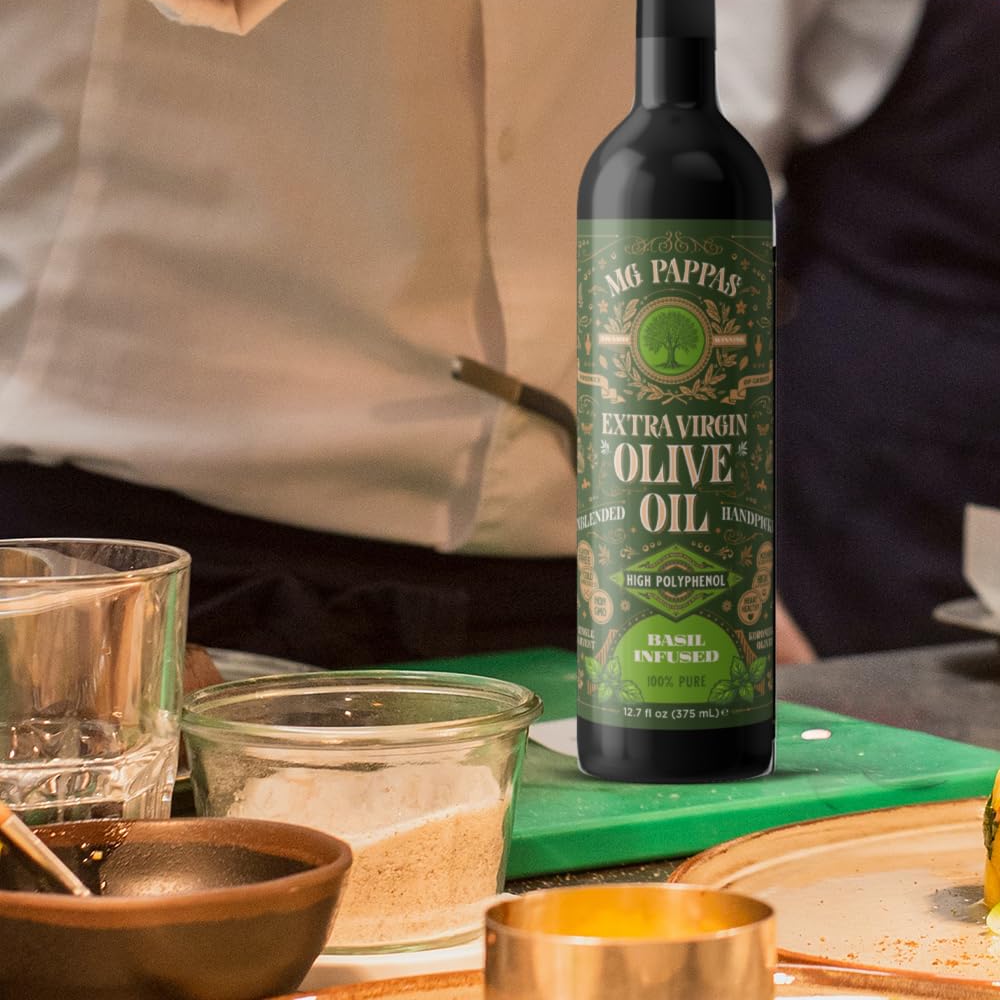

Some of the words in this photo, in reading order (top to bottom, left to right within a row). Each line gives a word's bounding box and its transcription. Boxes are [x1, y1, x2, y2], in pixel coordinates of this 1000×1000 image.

[604, 262, 643, 297] MG
[651, 257, 741, 297] PAPPAS
[602, 413, 673, 438] EXTRA
[676, 413, 748, 440] VIRGIN
[614, 442, 733, 488] OLIVE
[639, 492, 709, 534] OIL
[626, 573, 652, 588] HIGH
[656, 573, 726, 588] POLYPHENOL
[647, 634, 706, 647] BASIL
[632, 650, 720, 664] INFUSED
[647, 675, 674, 688] 100%
[679, 674, 706, 687] PURE
[623, 706, 641, 718] 12.7
[644, 707, 652, 718] fl
[655, 709, 668, 718] oz
[671, 707, 696, 719] (375
[698, 707, 720, 719] mL)
